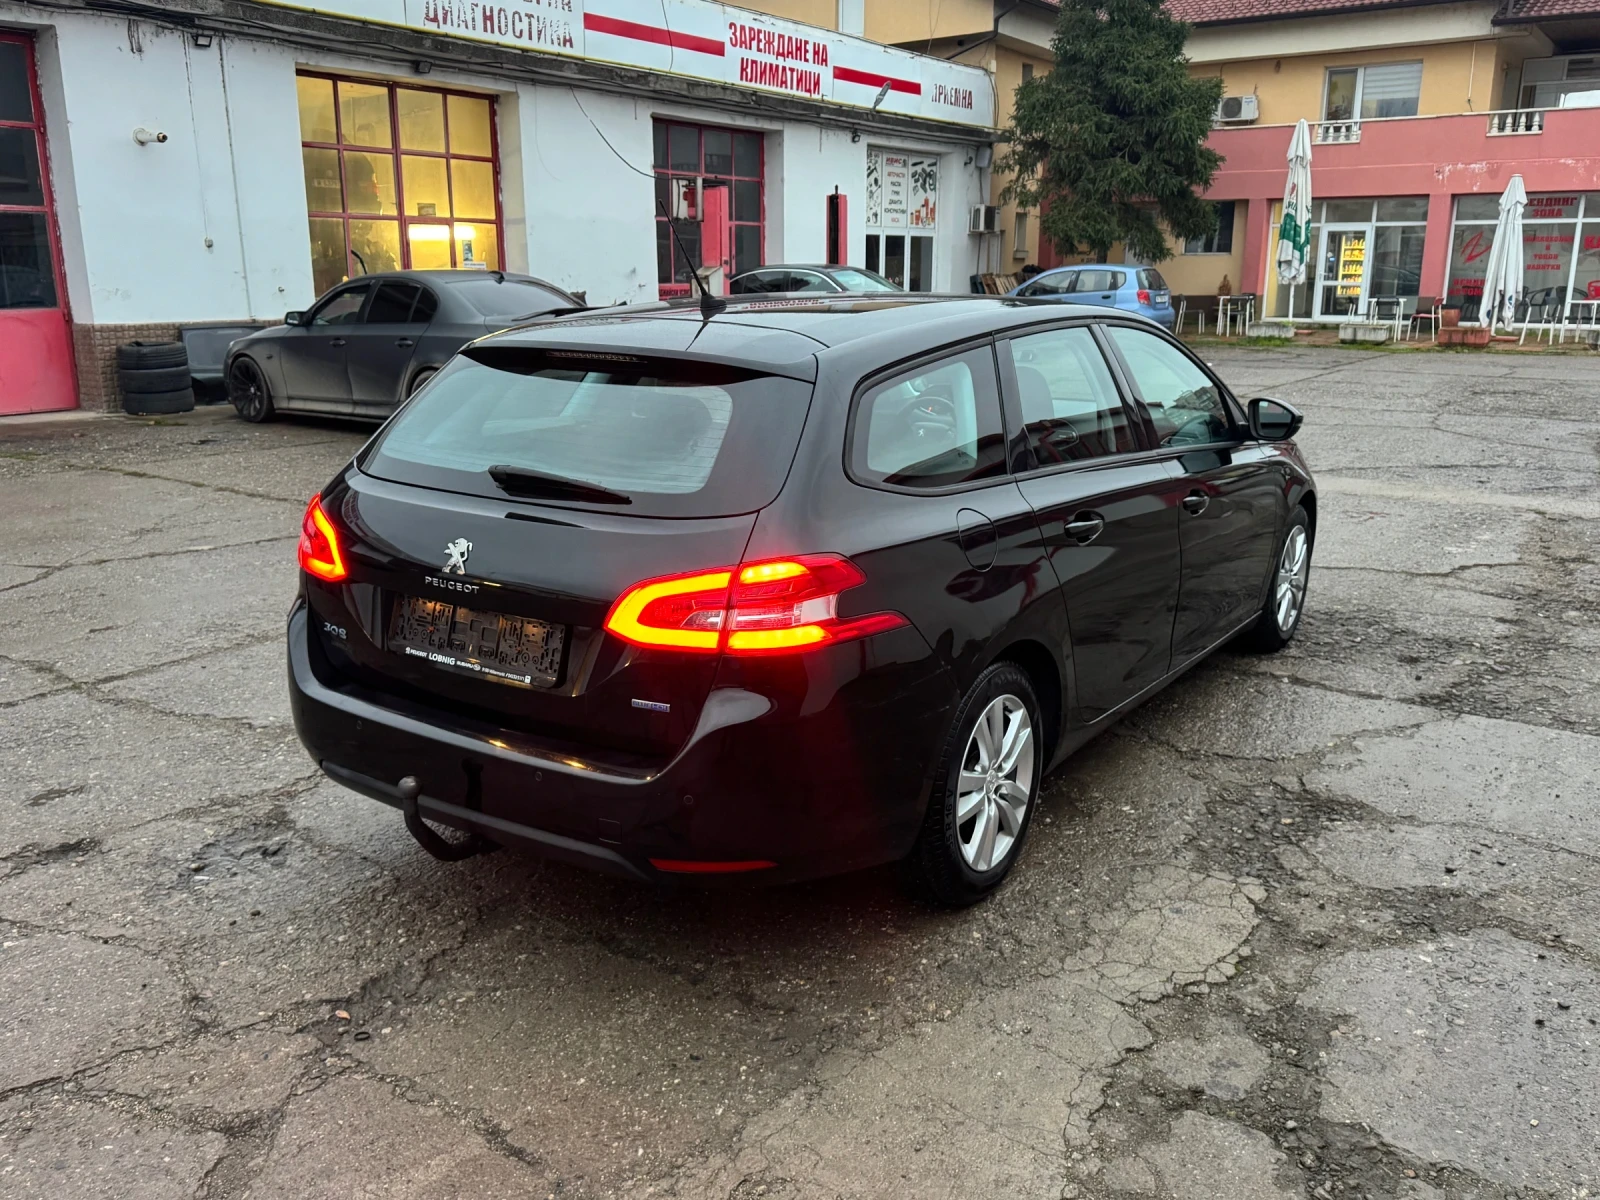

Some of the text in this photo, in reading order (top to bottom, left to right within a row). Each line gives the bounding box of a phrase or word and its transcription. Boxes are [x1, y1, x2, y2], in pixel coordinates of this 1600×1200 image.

[423, 0, 574, 48] ДИАГНОСТИКА
[728, 21, 828, 67] ЗАРЕЖДАНЕ НА
[739, 56, 821, 97] КЛИМАТИЦИ
[1526, 197, 1577, 207] ЕНДИНГ
[1532, 208, 1563, 218] ЗОНА
[1448, 287, 1484, 295] АВТОМ
[425, 575, 480, 594] PEUGEOT
[323, 621, 347, 640] 308
[428, 652, 456, 666] LOBNIG
